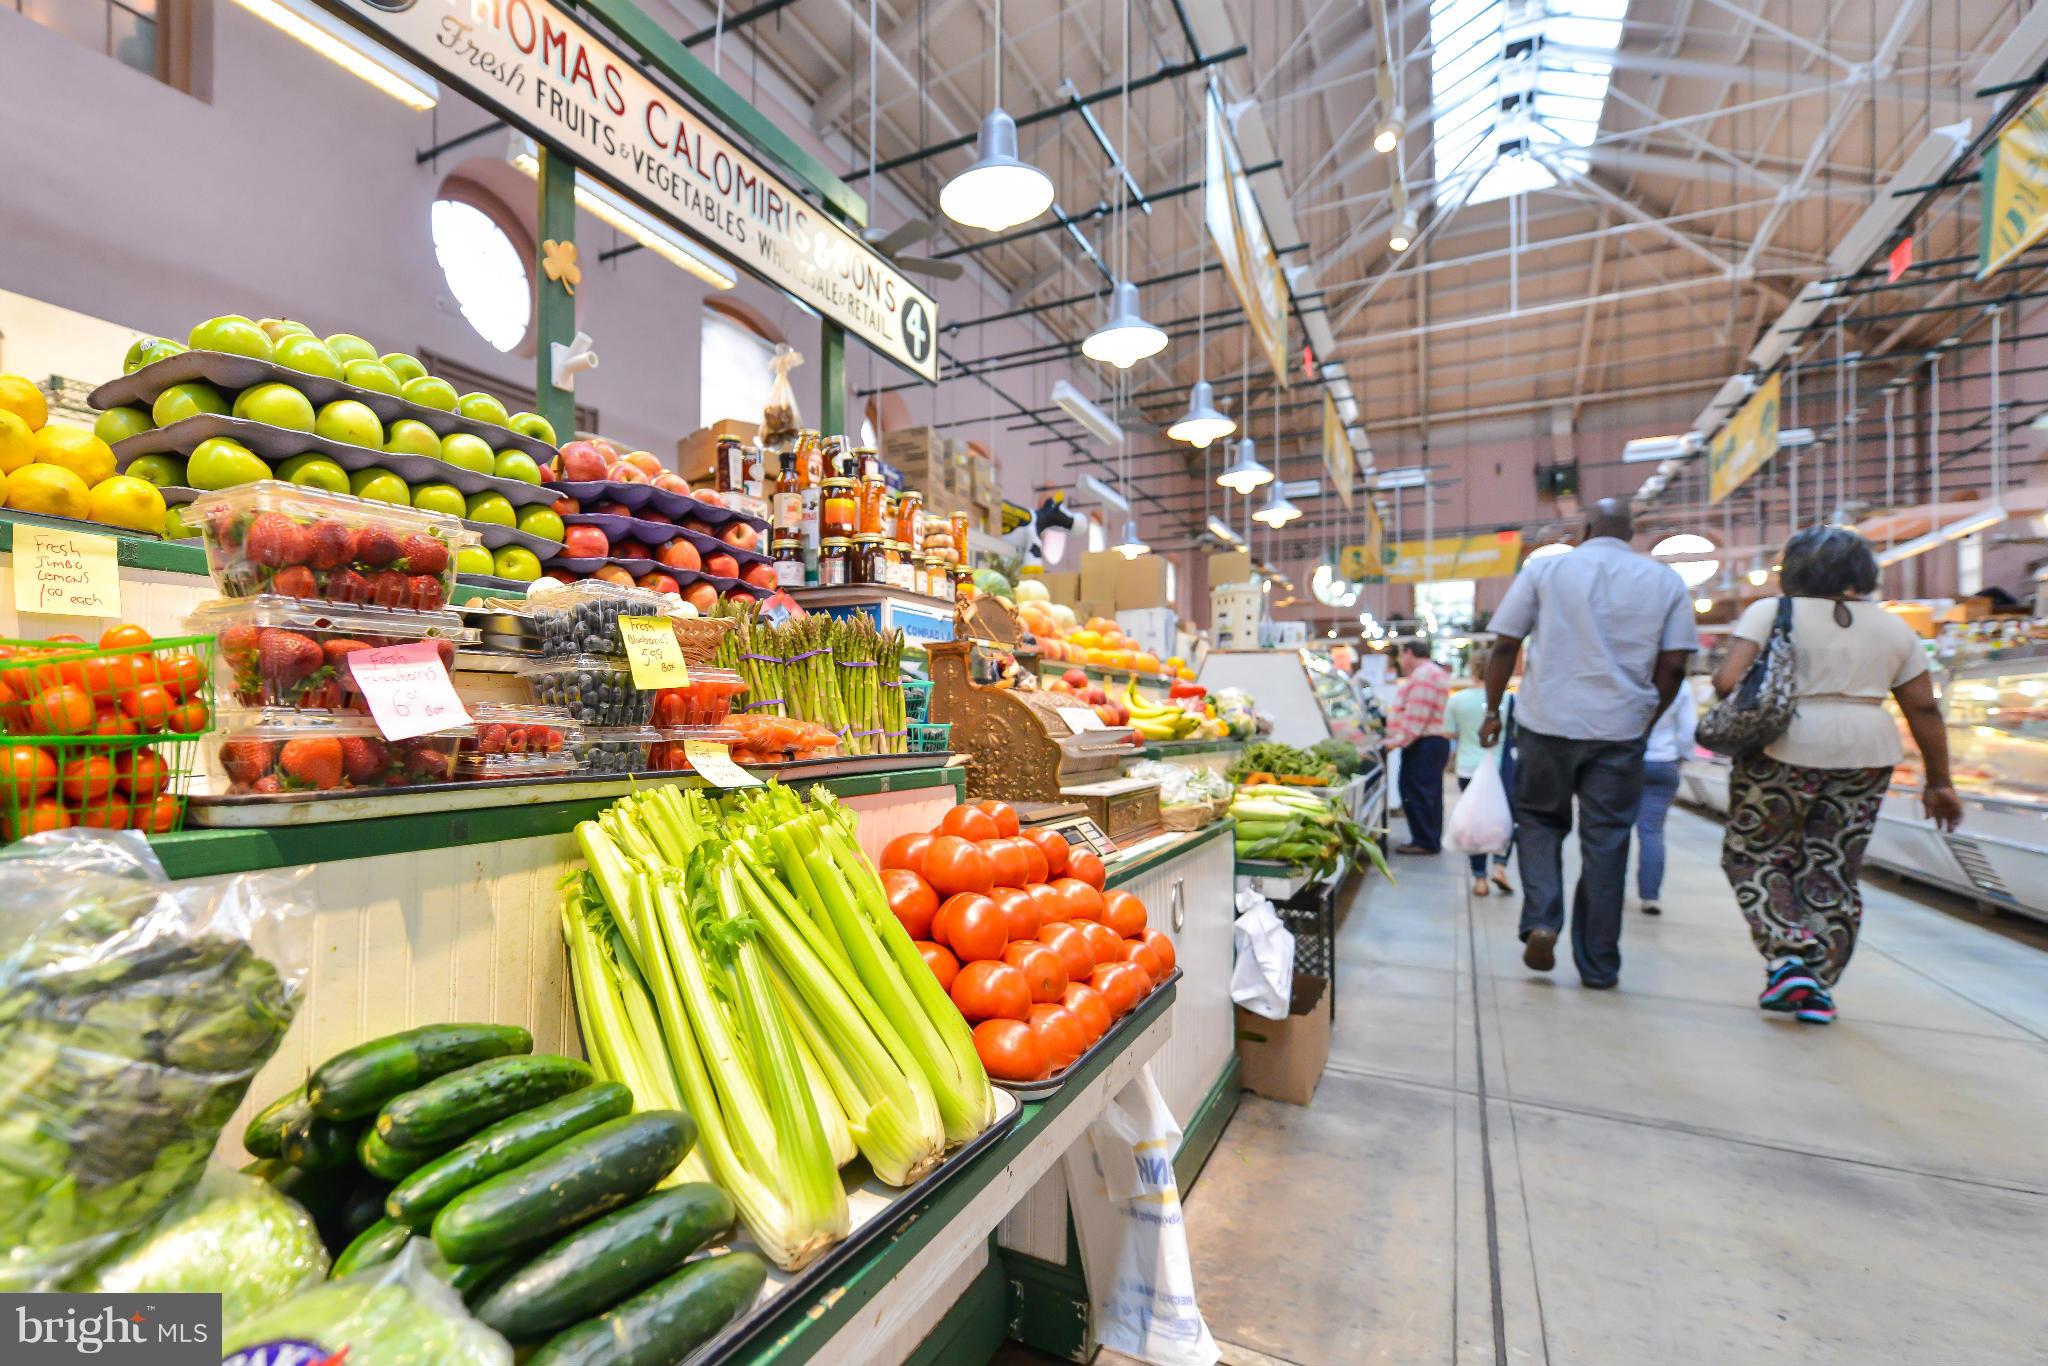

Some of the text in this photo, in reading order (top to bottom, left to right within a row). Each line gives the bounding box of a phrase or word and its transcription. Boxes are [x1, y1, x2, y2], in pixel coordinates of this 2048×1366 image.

[468, 0, 626, 116] HOMAS
[645, 99, 811, 252] CALOMIRIS
[436, 14, 526, 95] Fresh
[536, 77, 616, 156] FRUITS
[631, 143, 746, 244] VEGETABLES
[847, 293, 893, 341] RETAIL
[905, 302, 927, 360] 4
[34, 534, 81, 557] Fresh
[70, 593, 103, 606] each
[629, 617, 654, 632] Fresh
